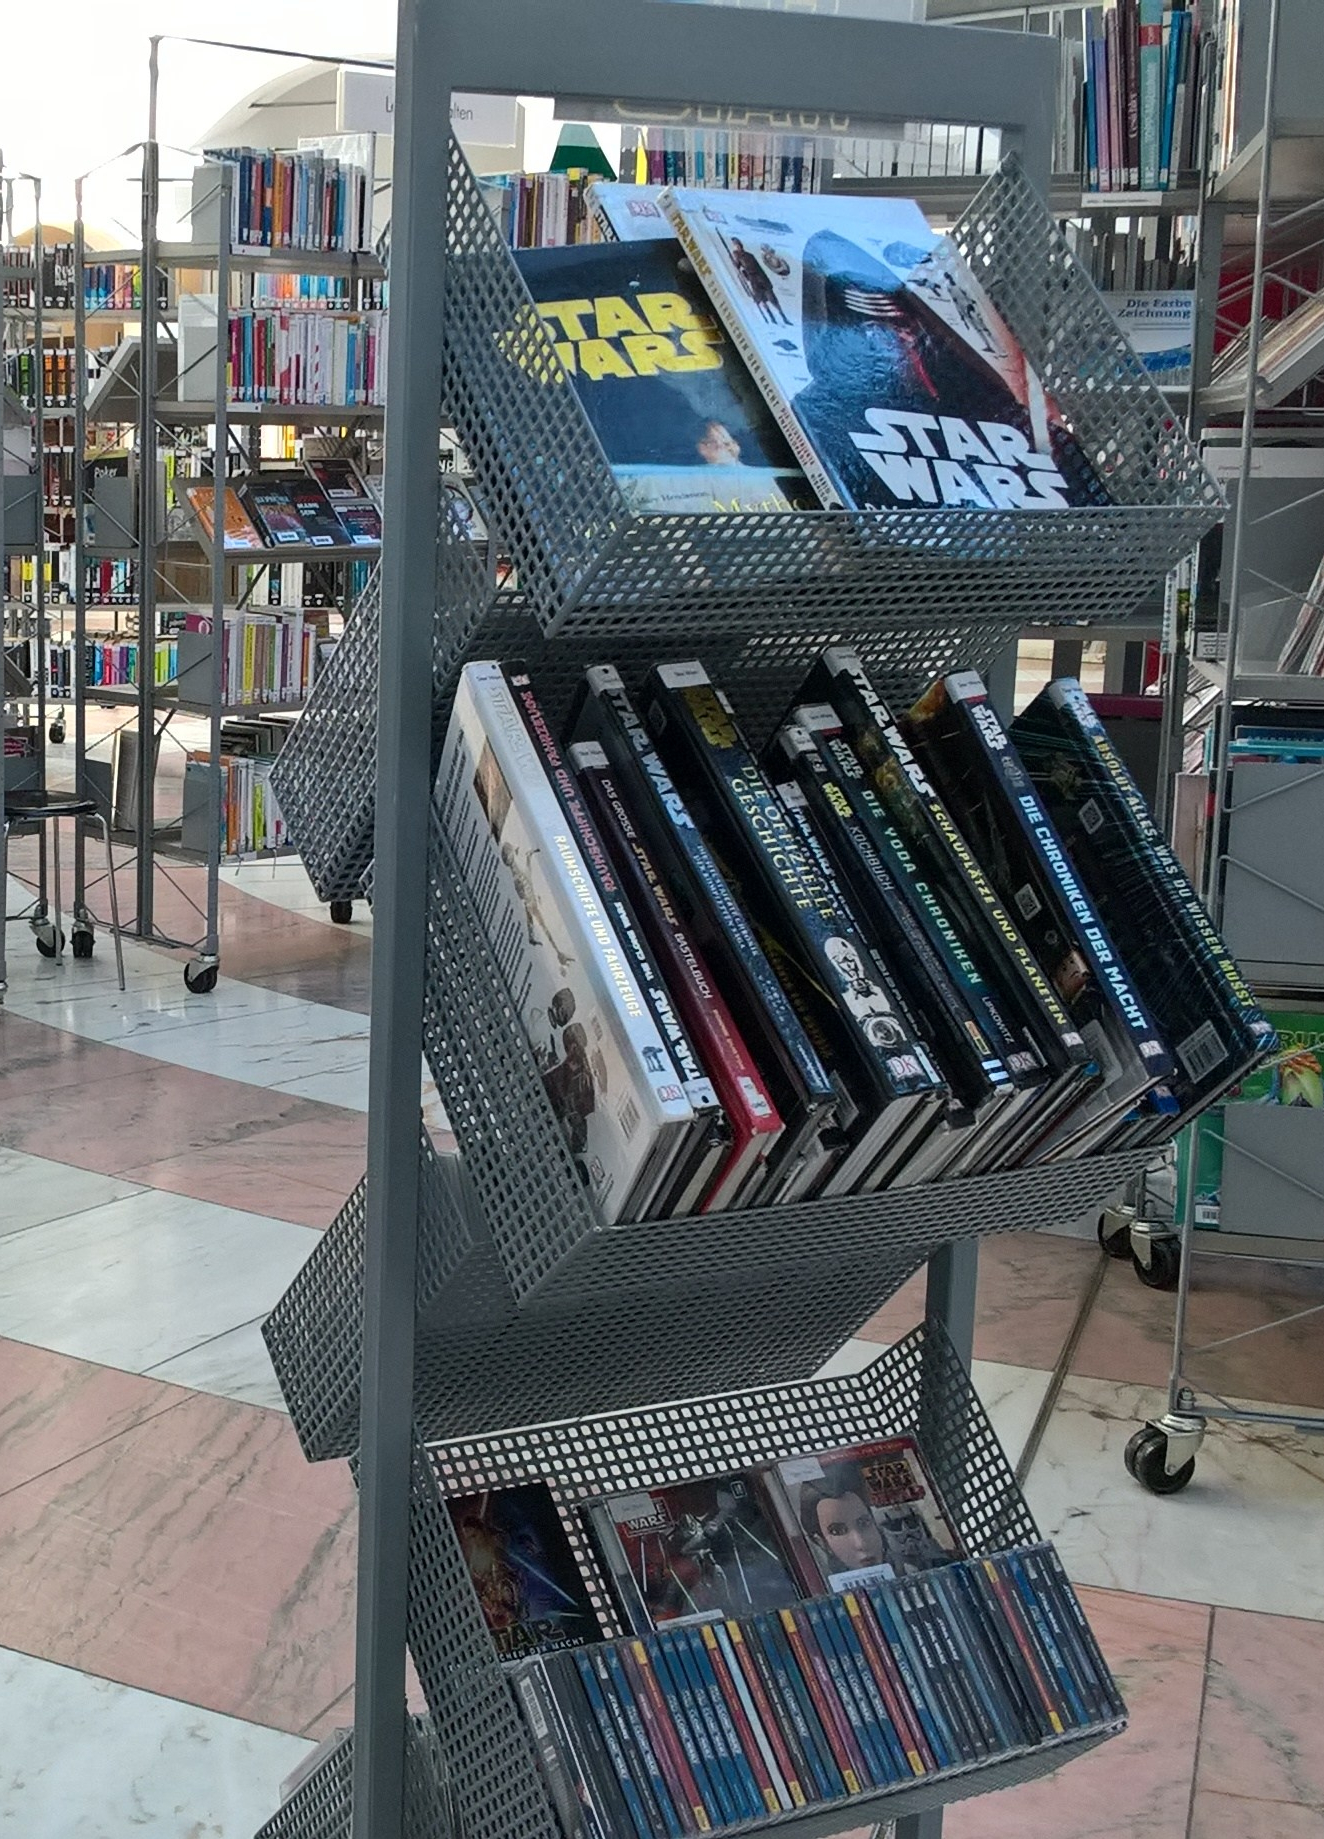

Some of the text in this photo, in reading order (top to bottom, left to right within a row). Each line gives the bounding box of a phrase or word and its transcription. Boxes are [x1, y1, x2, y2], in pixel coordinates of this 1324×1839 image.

[848, 407, 1059, 472] STAR
[94, 466, 118, 478] Poker
[859, 450, 1070, 509] WARS
[970, 704, 1006, 751] WARS
[981, 706, 1009, 748] STAR
[554, 768, 575, 798] UND
[607, 687, 696, 831] TAR WARS
[827, 738, 862, 780] WARS
[837, 739, 865, 776] STAR
[881, 725, 937, 799] WARS
[568, 801, 618, 892] RAUMSCHIFFE
[730, 776, 812, 910] GESCHICHTE
[740, 765, 769, 800] DIE
[763, 804, 837, 920] OFFIZIELLE
[791, 805, 812, 837] TAR
[848, 825, 896, 891] KOCHBUCH
[1091, 734, 1256, 1008] ABSOLUT ALLES, WAS DU WISSEN MUSST
[601, 778, 713, 1000] DAS GROSSE STAR WARS BASTELBUCH
[860, 788, 886, 819] DIE
[883, 826, 917, 873] YODA
[914, 881, 984, 985] CHRONIKEN
[1018, 794, 1148, 1031] DIE CHRONIKEN DER MACHT
[553, 834, 599, 918] RAUMSCHIFFE
[590, 920, 612, 946] UND
[601, 947, 644, 1018] FAHRZEUGE
[614, 900, 631, 929] WARS
[928, 802, 1068, 1026] SCHAUPLÄTZE UND PLANETEN
[626, 928, 646, 962] CLONE
[640, 961, 655, 982] THE
[648, 987, 682, 1041] WARS
[674, 1042, 701, 1081] TAR
[886, 1054, 926, 1082] DK
[626, 1513, 667, 1531] WARS
[551, 1635, 586, 1652] MACHT
